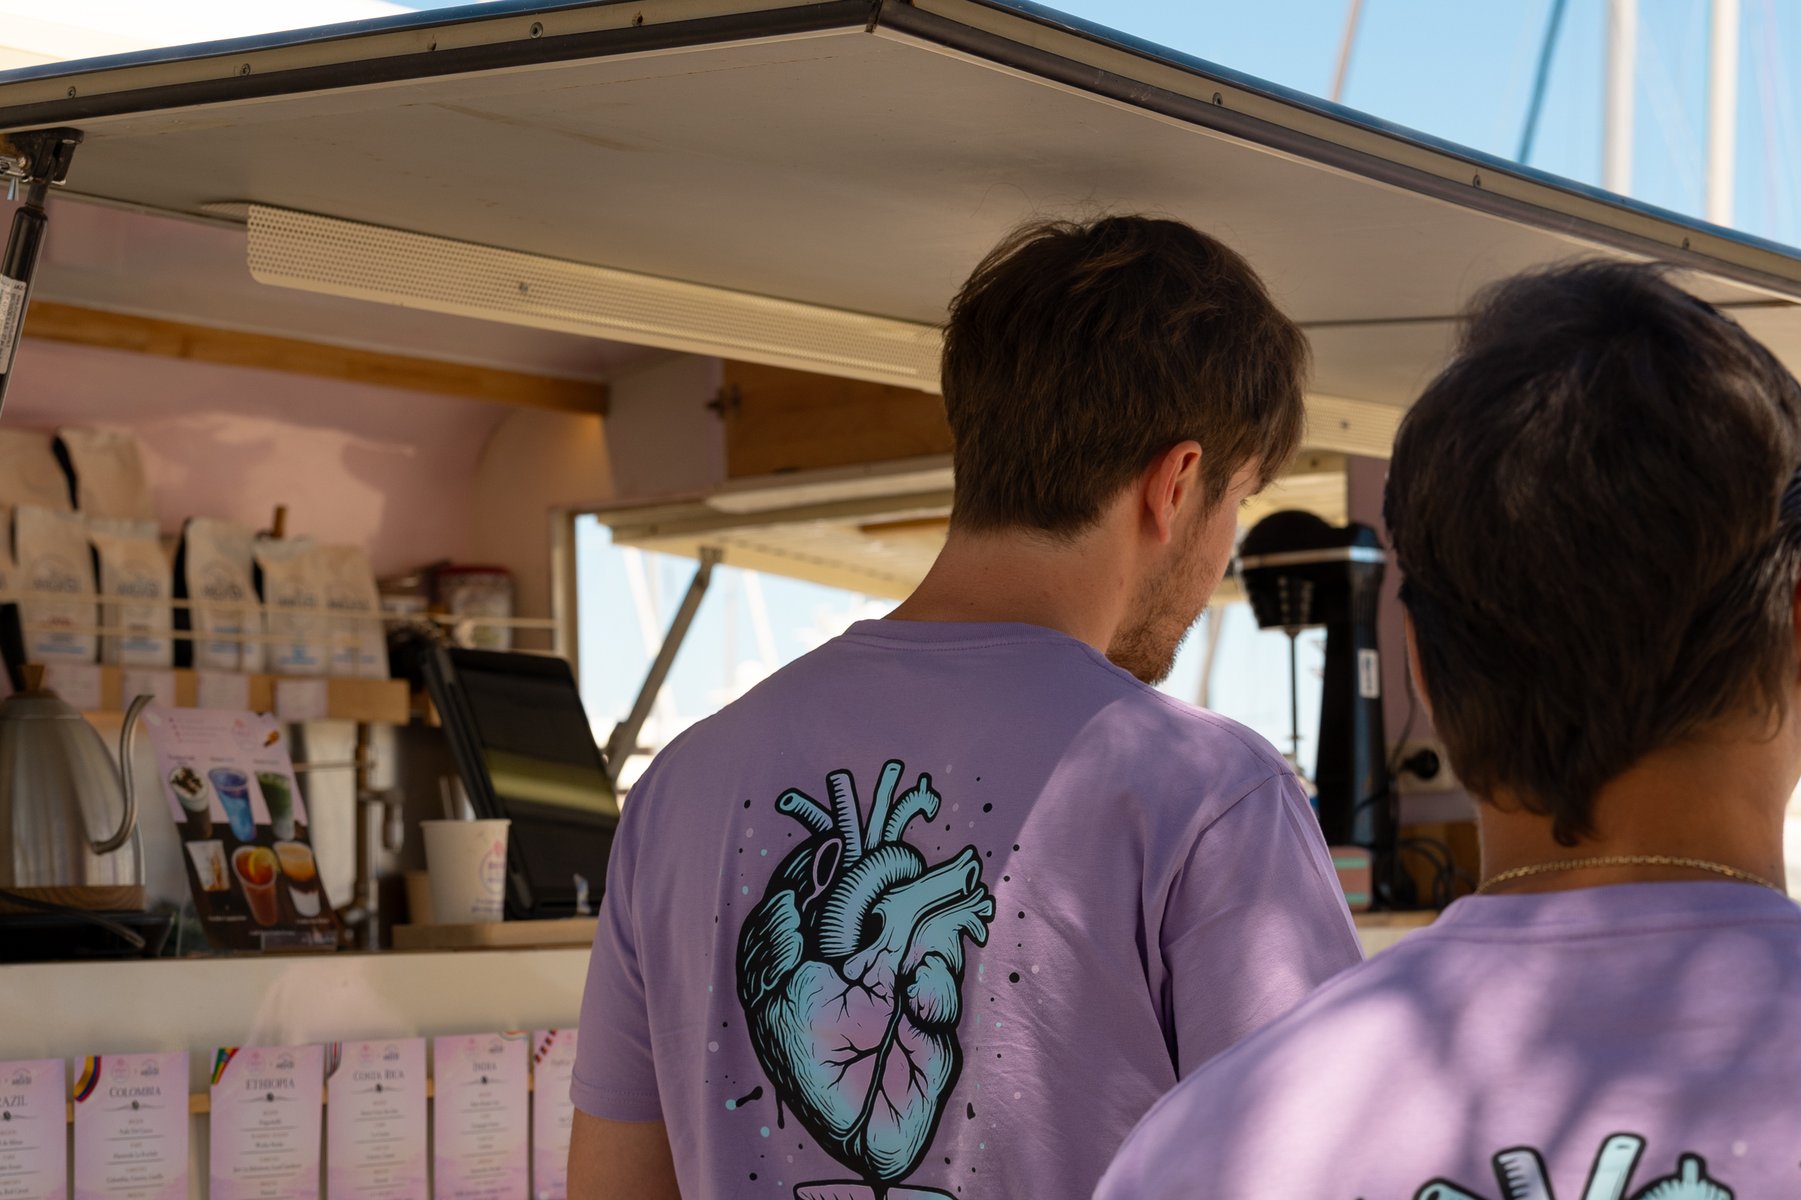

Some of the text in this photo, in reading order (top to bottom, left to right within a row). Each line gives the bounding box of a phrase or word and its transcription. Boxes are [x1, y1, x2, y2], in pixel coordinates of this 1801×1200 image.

[245, 1078, 295, 1091] ETHIOPIA
[109, 1086, 161, 1098] COLOMBIA
[0, 1094, 28, 1108] AZIL
